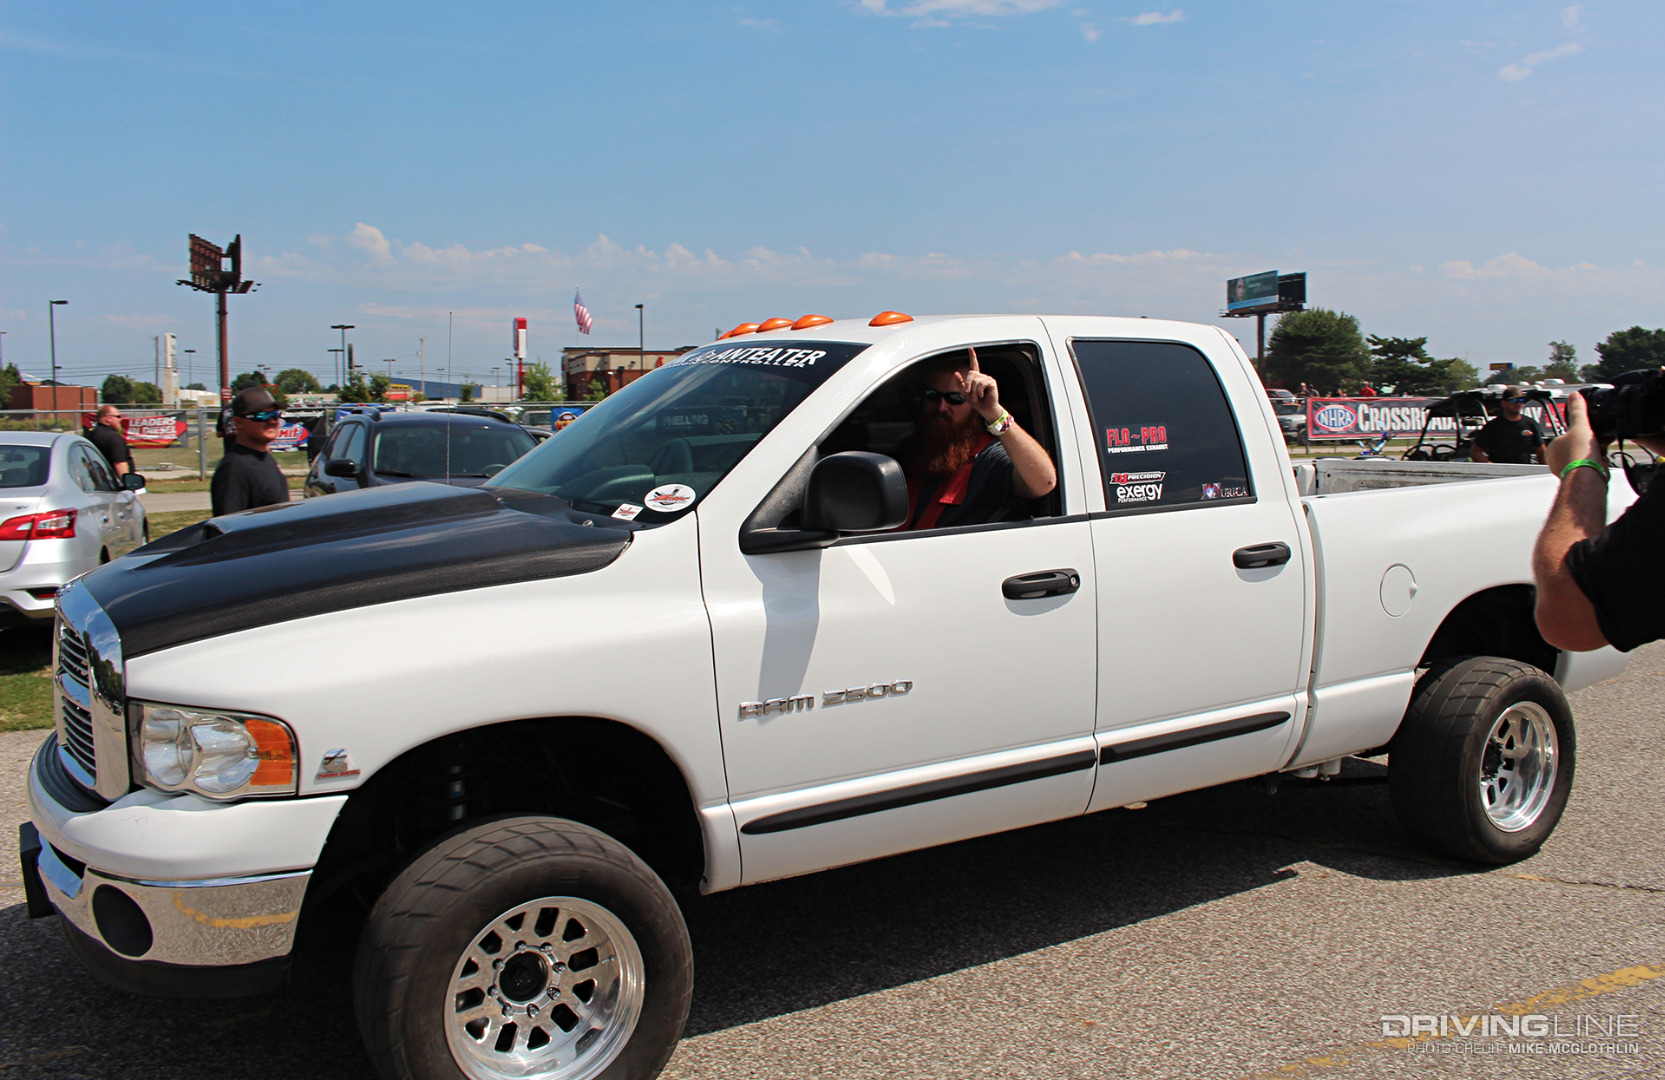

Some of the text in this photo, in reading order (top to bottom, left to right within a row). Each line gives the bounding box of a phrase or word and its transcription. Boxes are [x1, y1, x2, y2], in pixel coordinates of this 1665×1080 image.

[712, 347, 827, 366] ANTEATER
[128, 416, 177, 427] LEADERS
[1319, 408, 1355, 427] NHRA
[142, 425, 177, 435] DIESEL
[1128, 473, 1162, 481] PRECISION
[1116, 483, 1164, 501] exergy
[738, 679, 914, 720] RAM 2500
